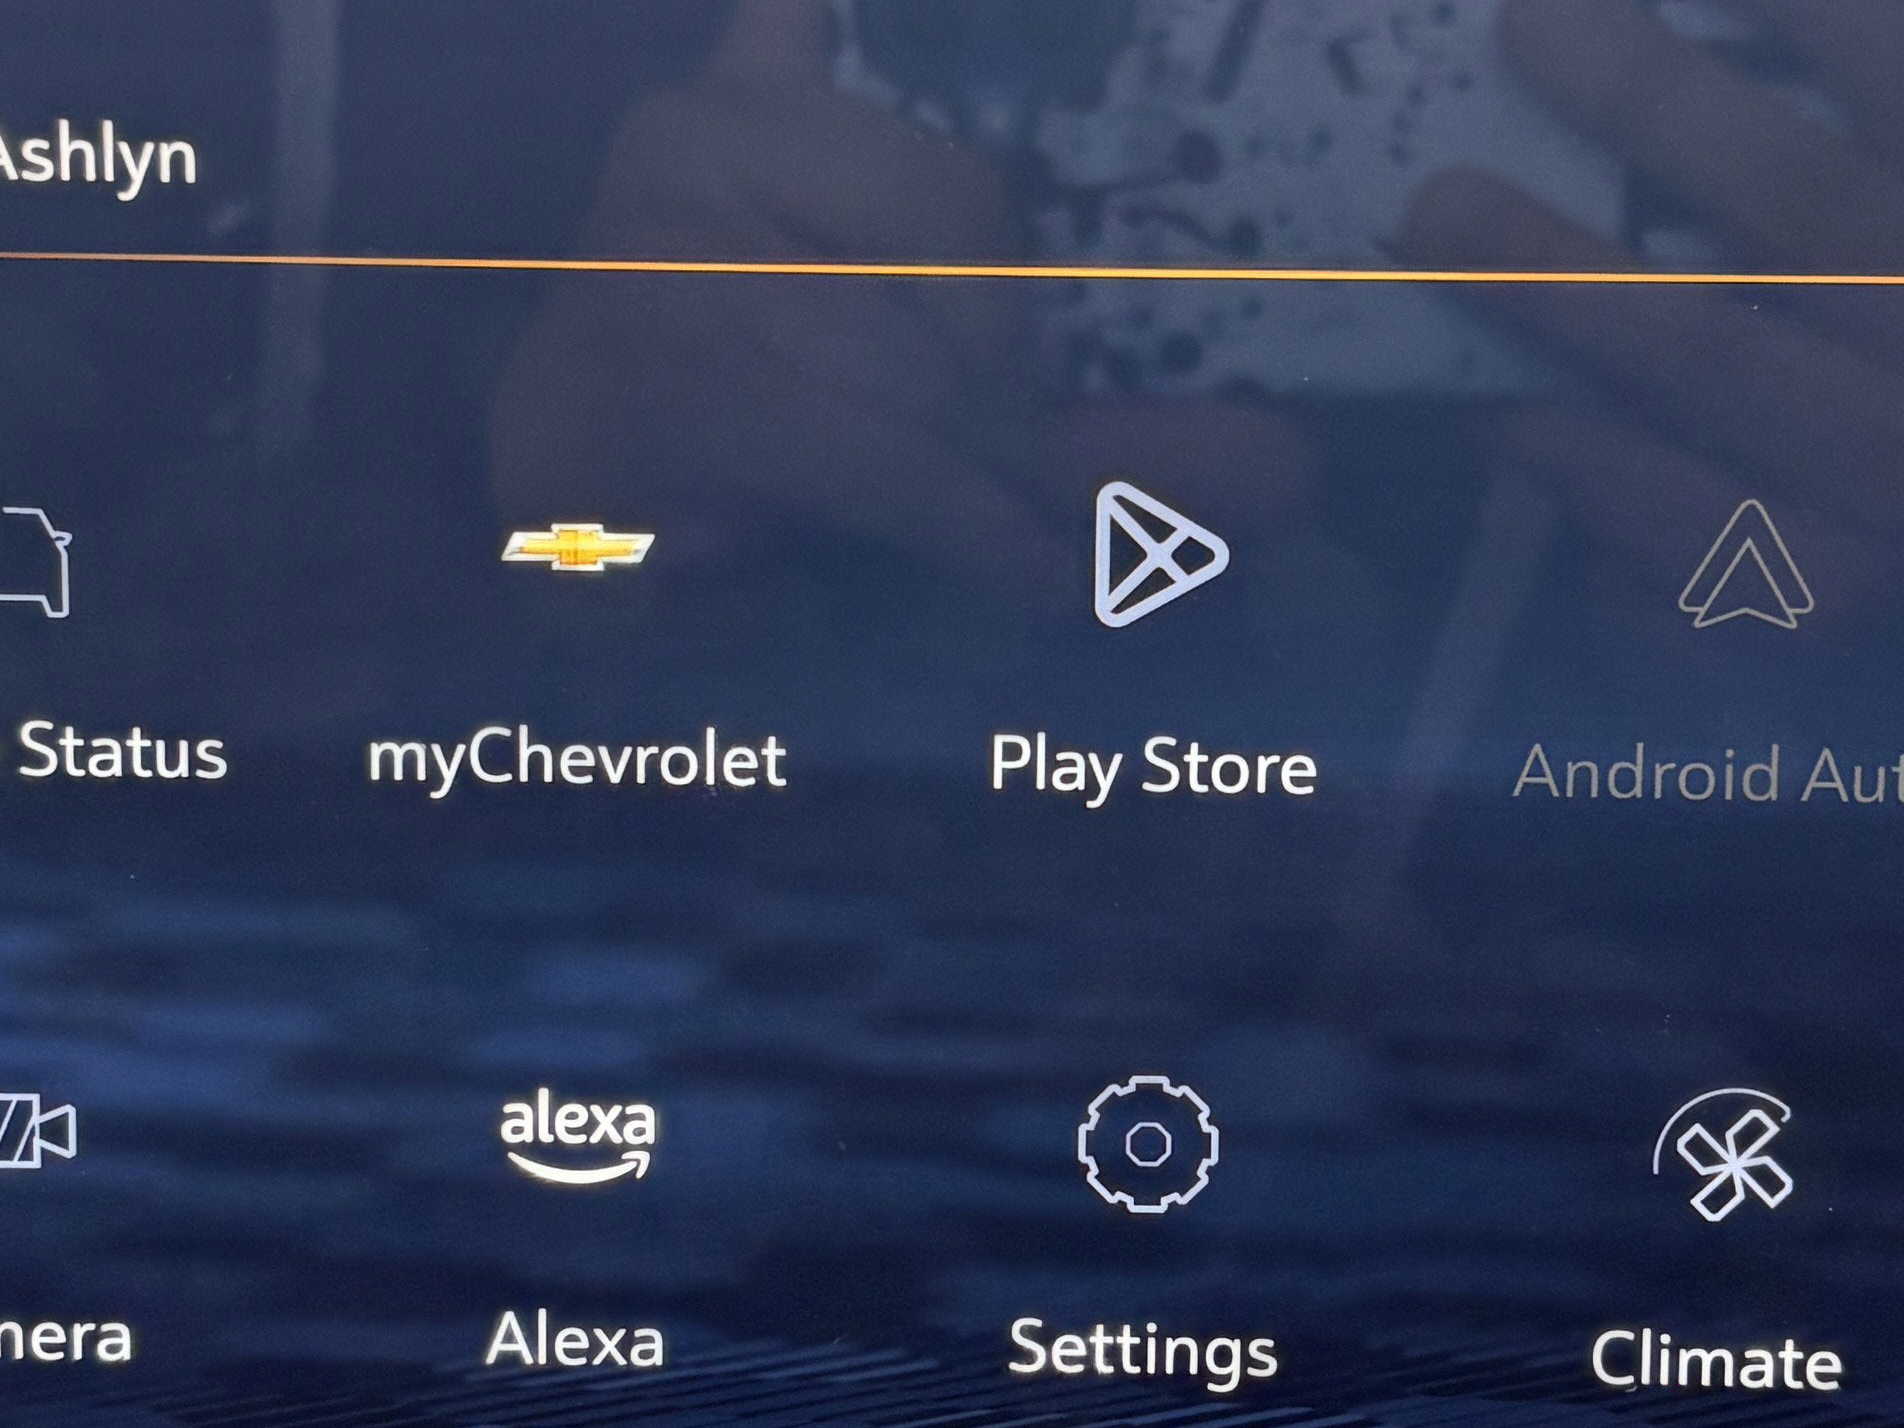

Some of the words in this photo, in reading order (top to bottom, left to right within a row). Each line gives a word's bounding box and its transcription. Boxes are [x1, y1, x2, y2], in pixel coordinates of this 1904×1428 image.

[18, 719, 229, 780] Status
[369, 723, 788, 800] myChevrolet
[992, 730, 1125, 810] Play
[1141, 735, 1318, 796] Store
[1512, 741, 1780, 802] Android
[499, 1086, 657, 1146] alexa
[484, 1306, 664, 1368] Alexa
[1007, 1316, 1279, 1394] Settings
[1591, 1326, 1843, 1391] Climate
